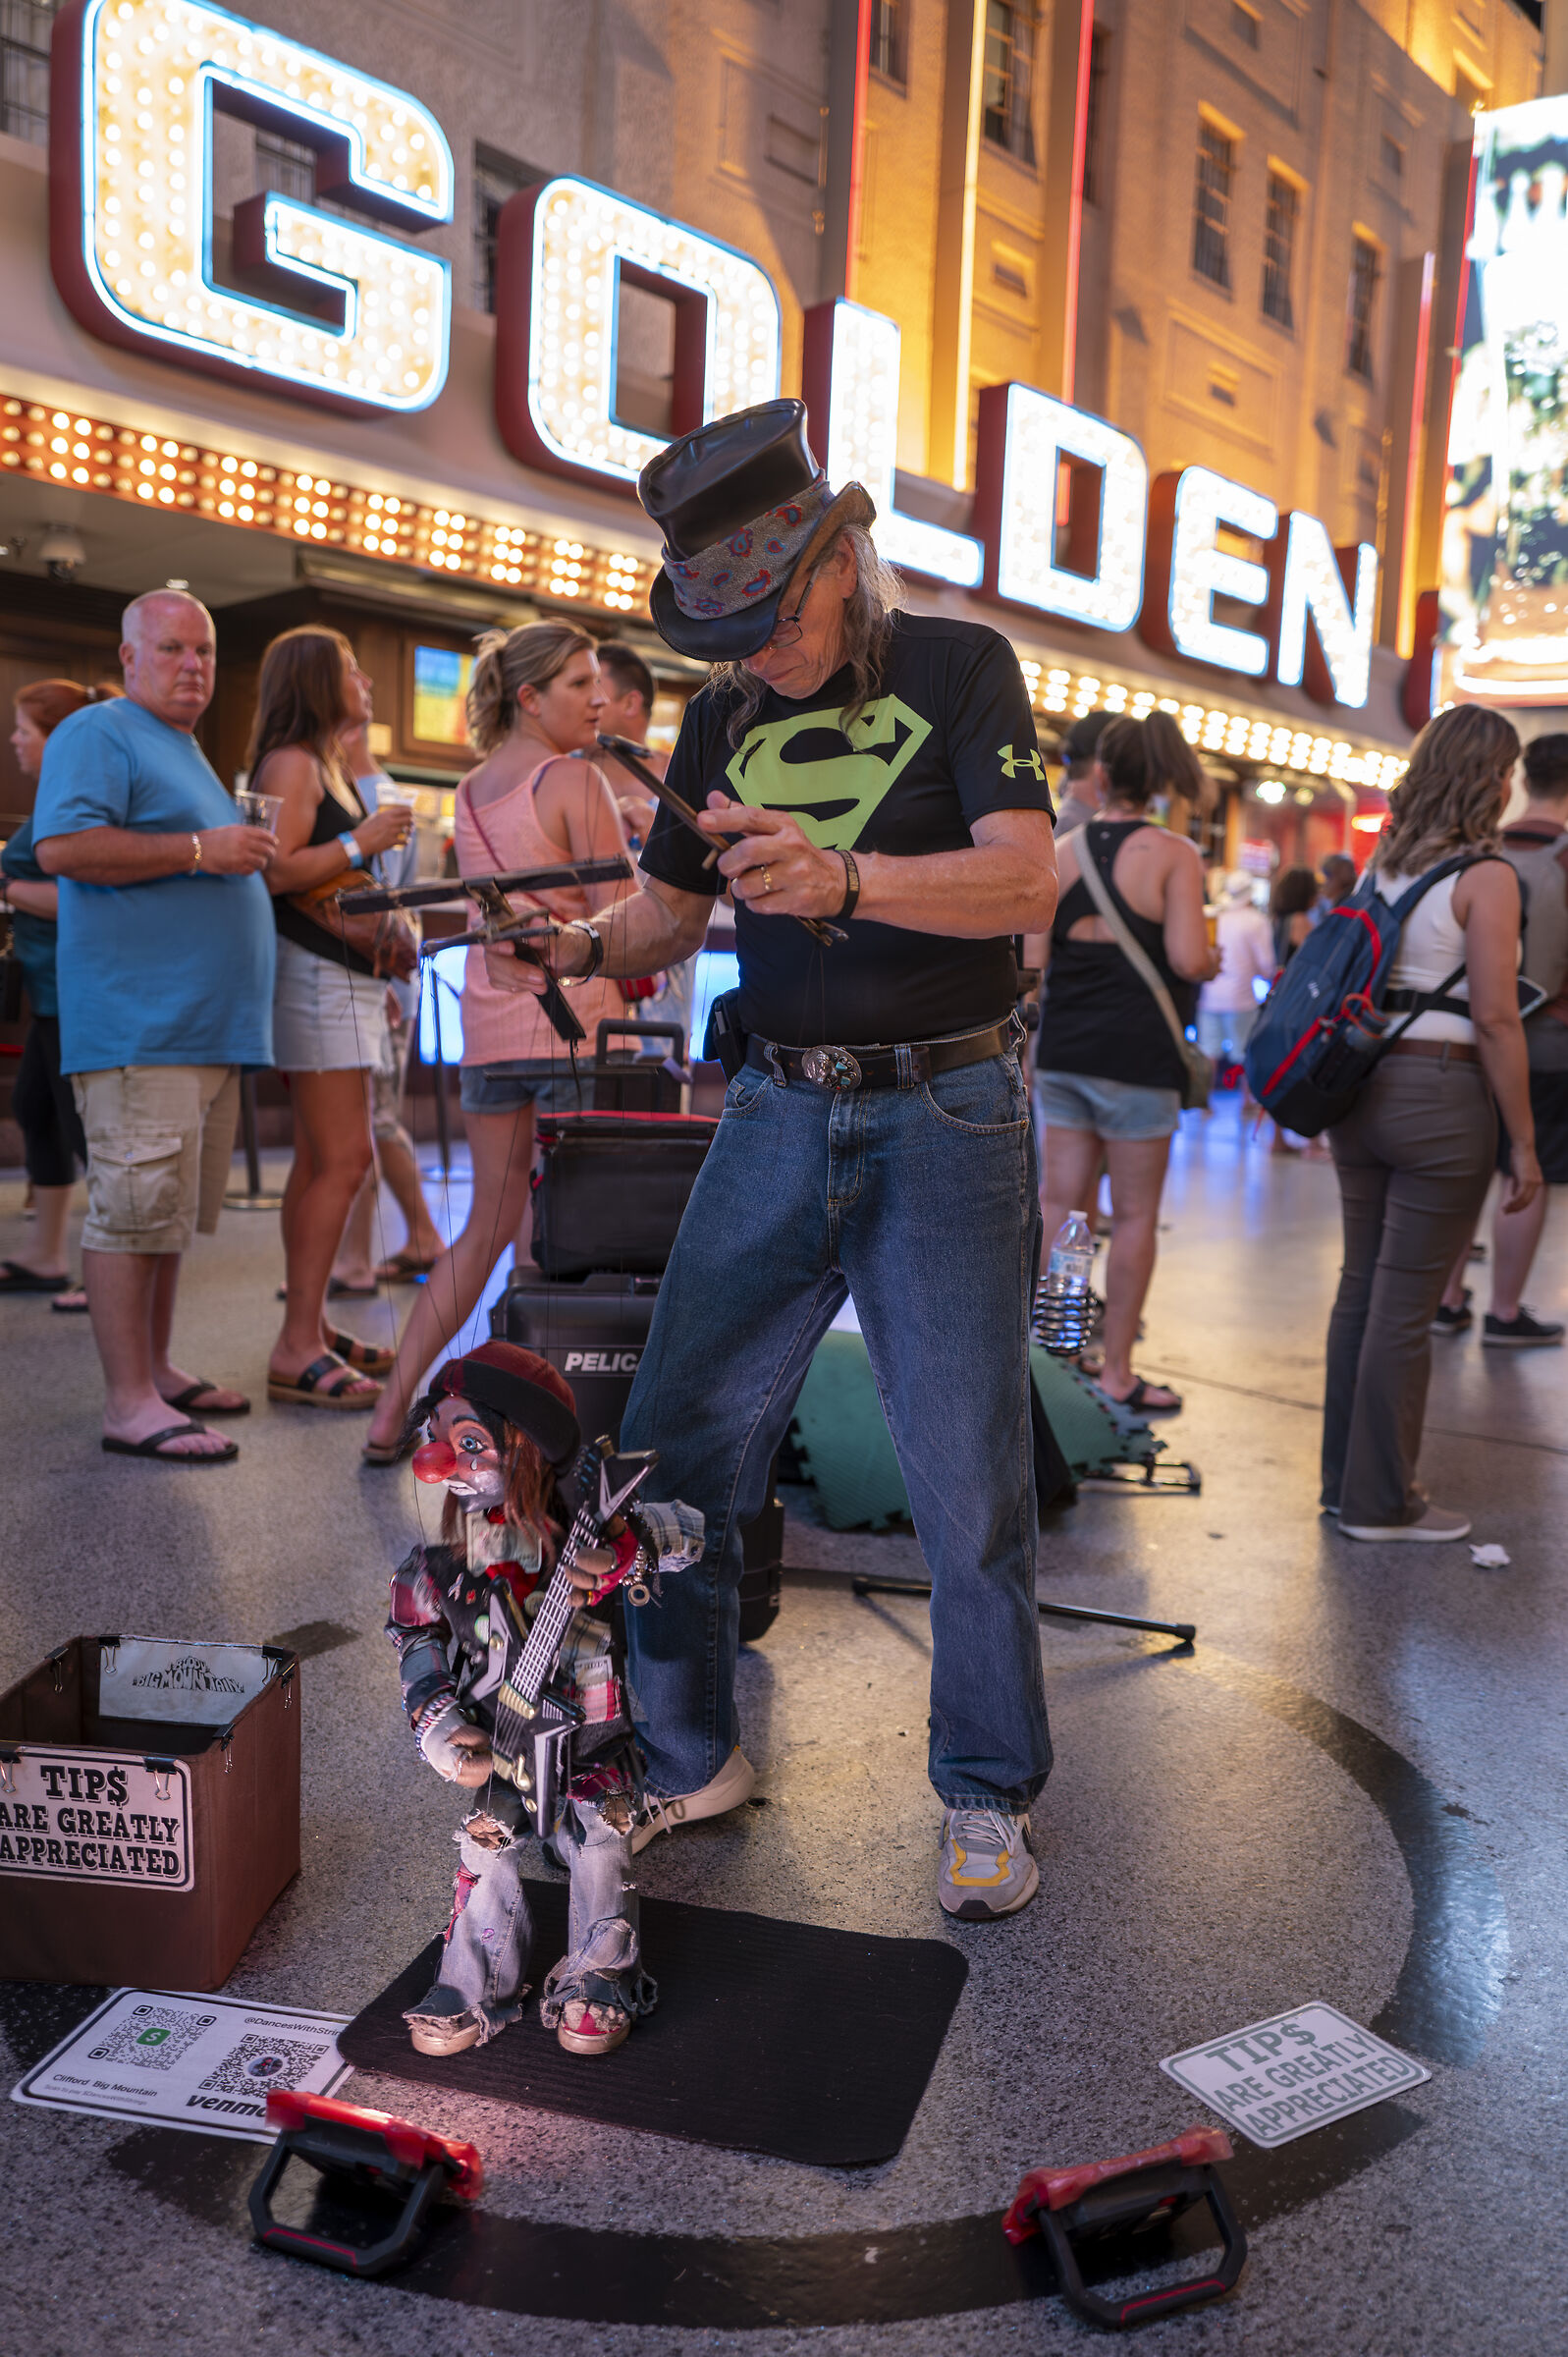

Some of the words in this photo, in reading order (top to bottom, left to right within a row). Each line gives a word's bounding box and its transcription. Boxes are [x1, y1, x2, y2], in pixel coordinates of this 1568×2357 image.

[81, 0, 1378, 709] GOLDEN
[565, 1351, 639, 1373] PELIC
[40, 1765, 129, 1810] TIP$
[0, 1801, 48, 1833] ARE
[57, 1807, 181, 1845] GREATLY
[0, 1835, 182, 1878] APPRECIATED
[1204, 2021, 1319, 2072] TIP$
[52, 2074, 90, 2086] Clifford
[92, 2080, 110, 2090] Big
[111, 2083, 157, 2097] Mountain
[1214, 2076, 1273, 2111] ARE
[1265, 2033, 1377, 2089] GREATLY
[1245, 2056, 1409, 2136] APPRECIATED
